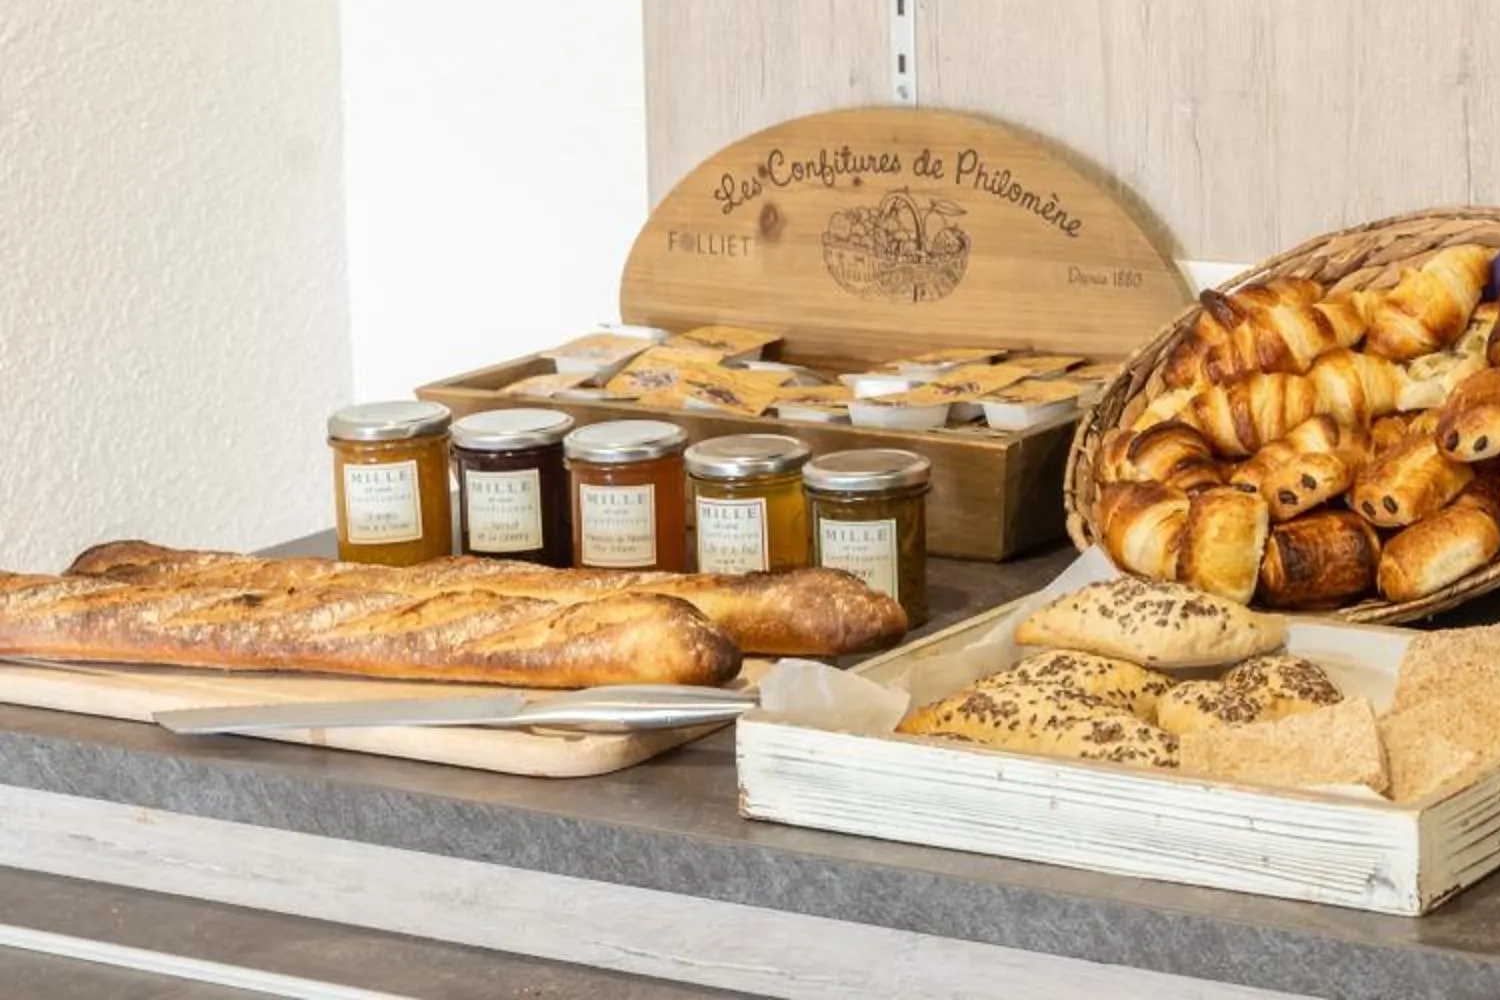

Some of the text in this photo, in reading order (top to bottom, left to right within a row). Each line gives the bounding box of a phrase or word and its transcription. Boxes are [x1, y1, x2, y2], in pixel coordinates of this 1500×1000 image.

[714, 148, 1082, 238] Les Confitures de Philomène
